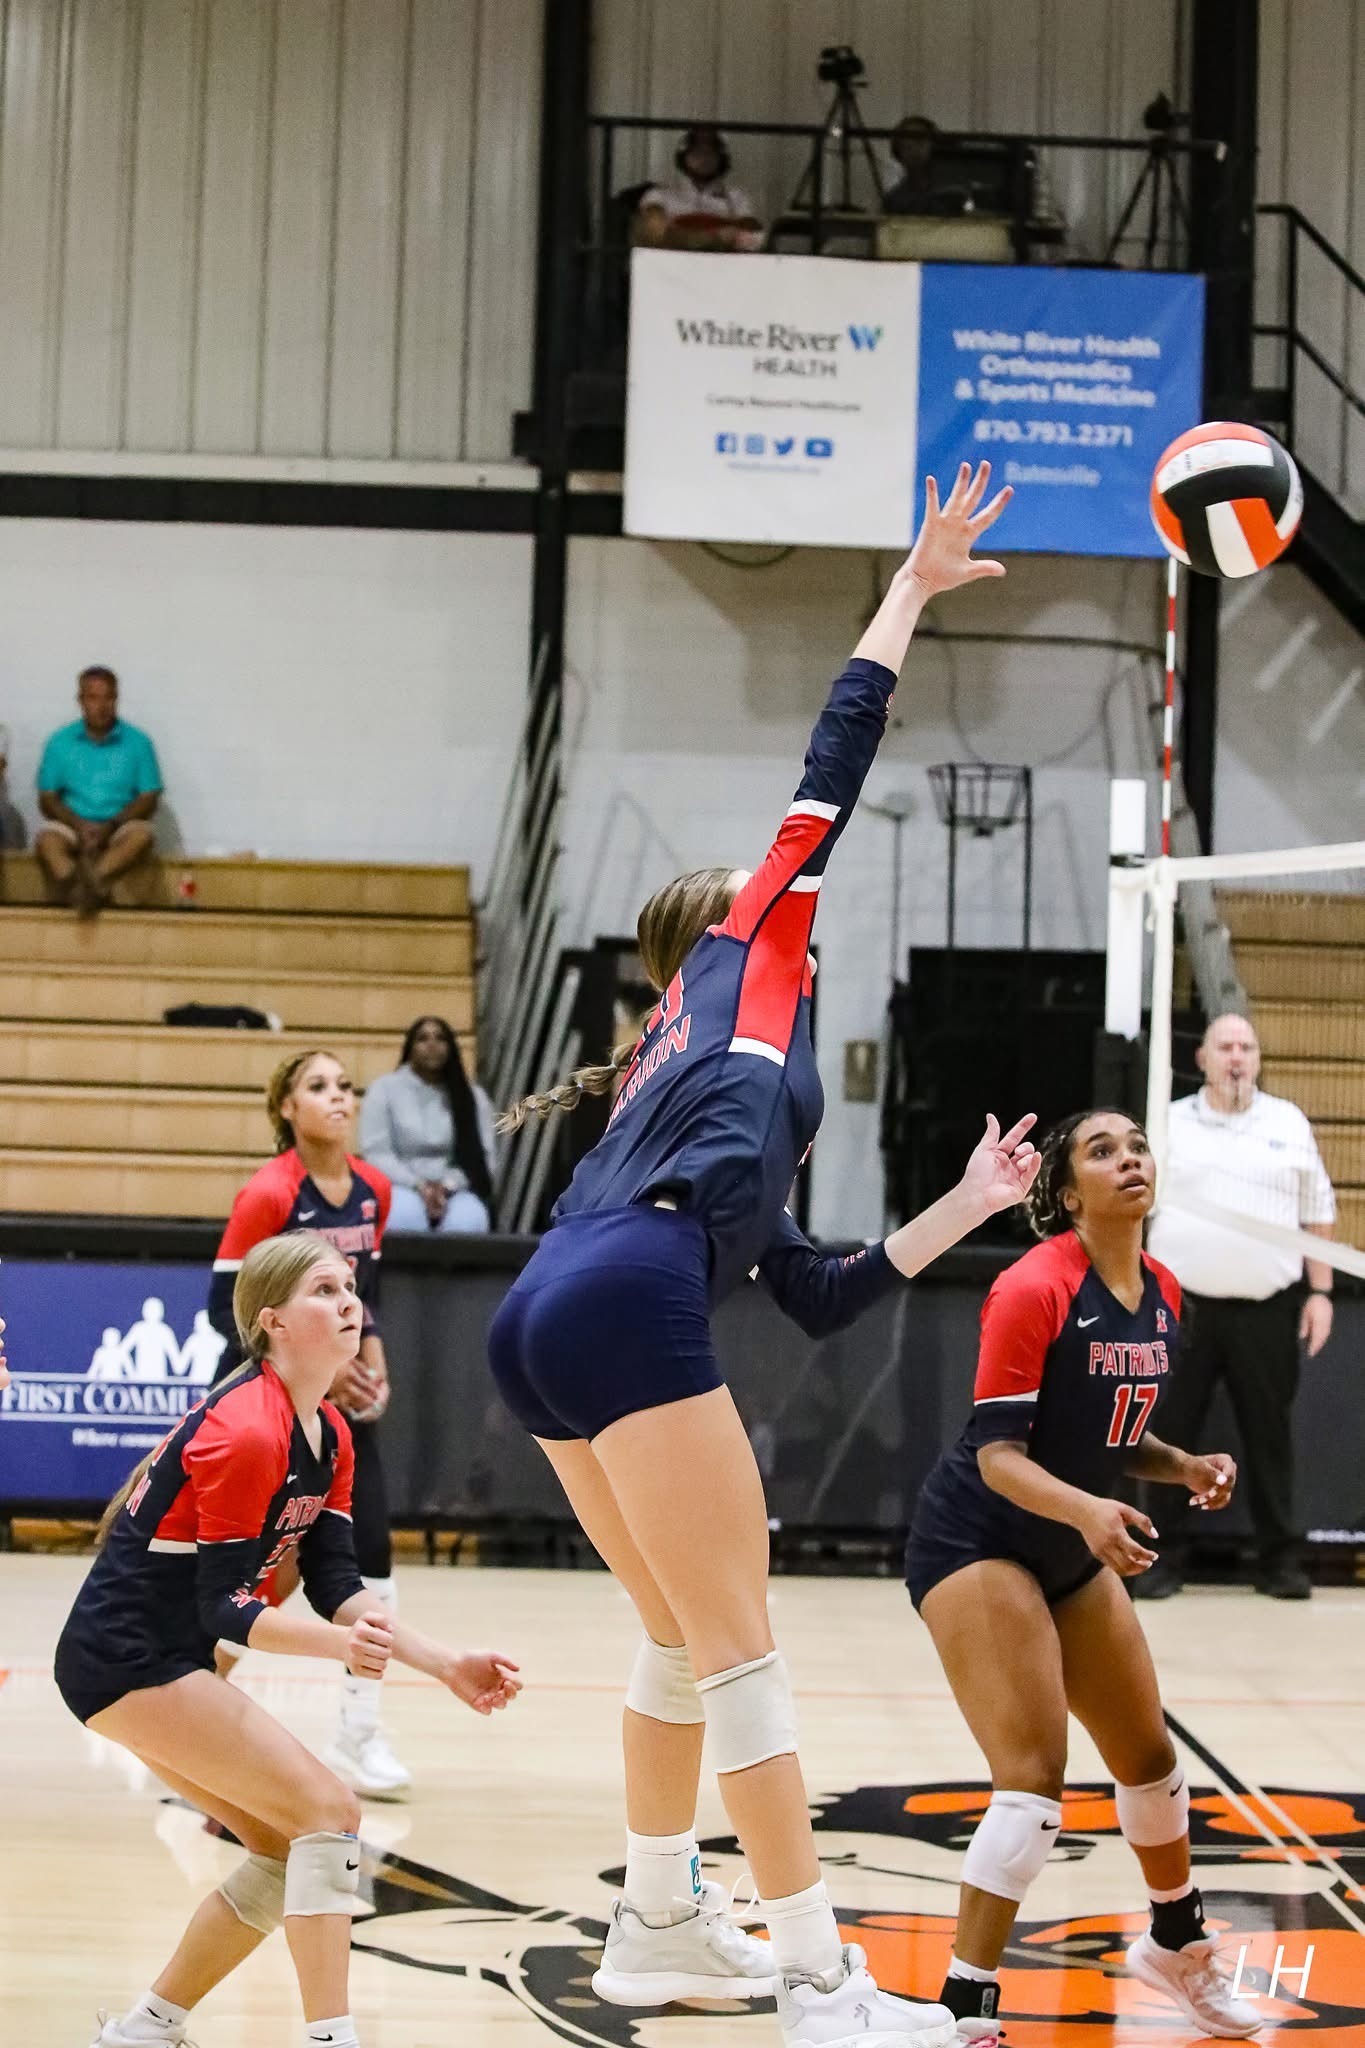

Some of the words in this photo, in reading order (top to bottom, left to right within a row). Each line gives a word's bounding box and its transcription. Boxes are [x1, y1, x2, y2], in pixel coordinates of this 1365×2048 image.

[676, 318, 763, 349] White
[767, 323, 841, 351] River
[953, 329, 1021, 350] White
[1024, 331, 1082, 354] River
[1085, 335, 1160, 358] Health
[753, 357, 838, 378] HEALTH
[977, 379, 1050, 403] Sports
[1053, 381, 1156, 407] Medicine
[1089, 1340, 1169, 1377] PATRIOTS
[1, 1379, 82, 1413] FIRST
[1106, 1383, 1159, 1447] 17
